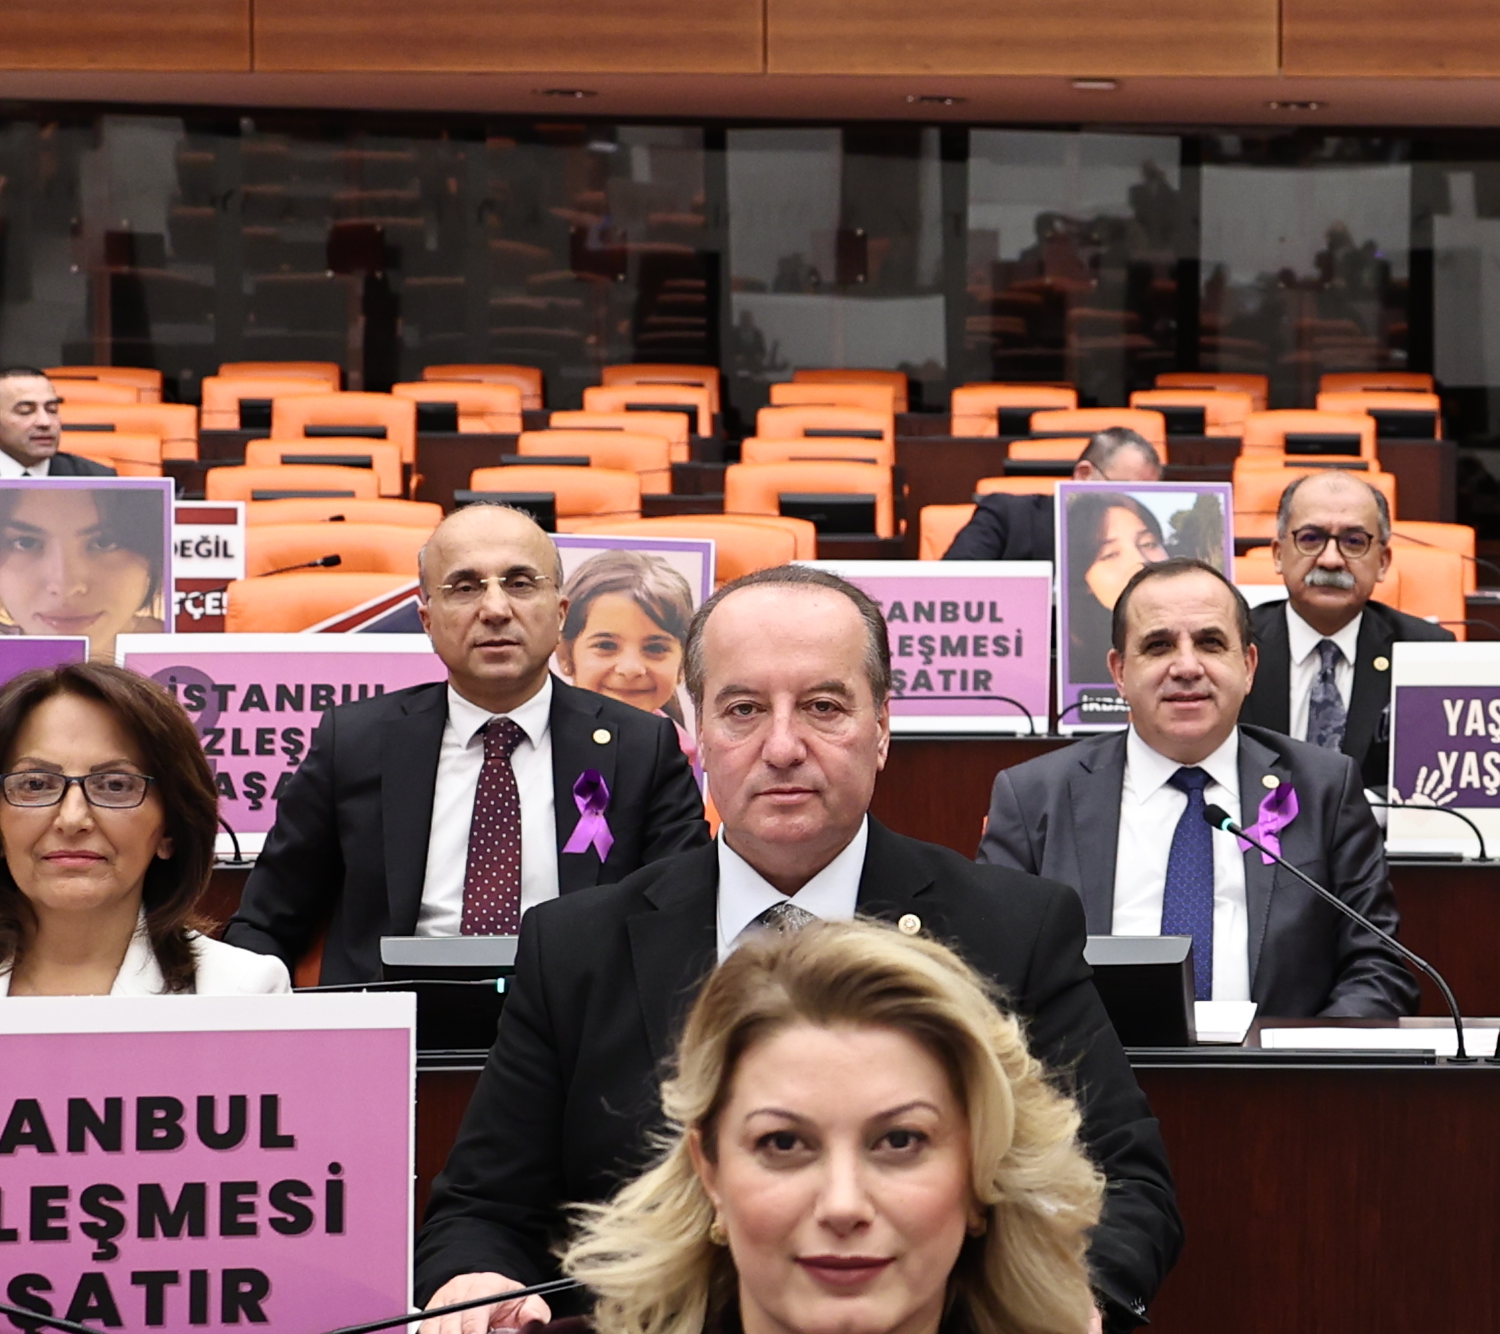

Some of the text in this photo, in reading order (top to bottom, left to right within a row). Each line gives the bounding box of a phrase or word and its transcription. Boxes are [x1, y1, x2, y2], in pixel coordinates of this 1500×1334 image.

[175, 535, 235, 558] EĞİL
[174, 591, 229, 620] TÇE!
[873, 601, 1004, 623] ANBUL
[890, 628, 1023, 665] EŞMESİ
[891, 669, 992, 697] ŞATIR
